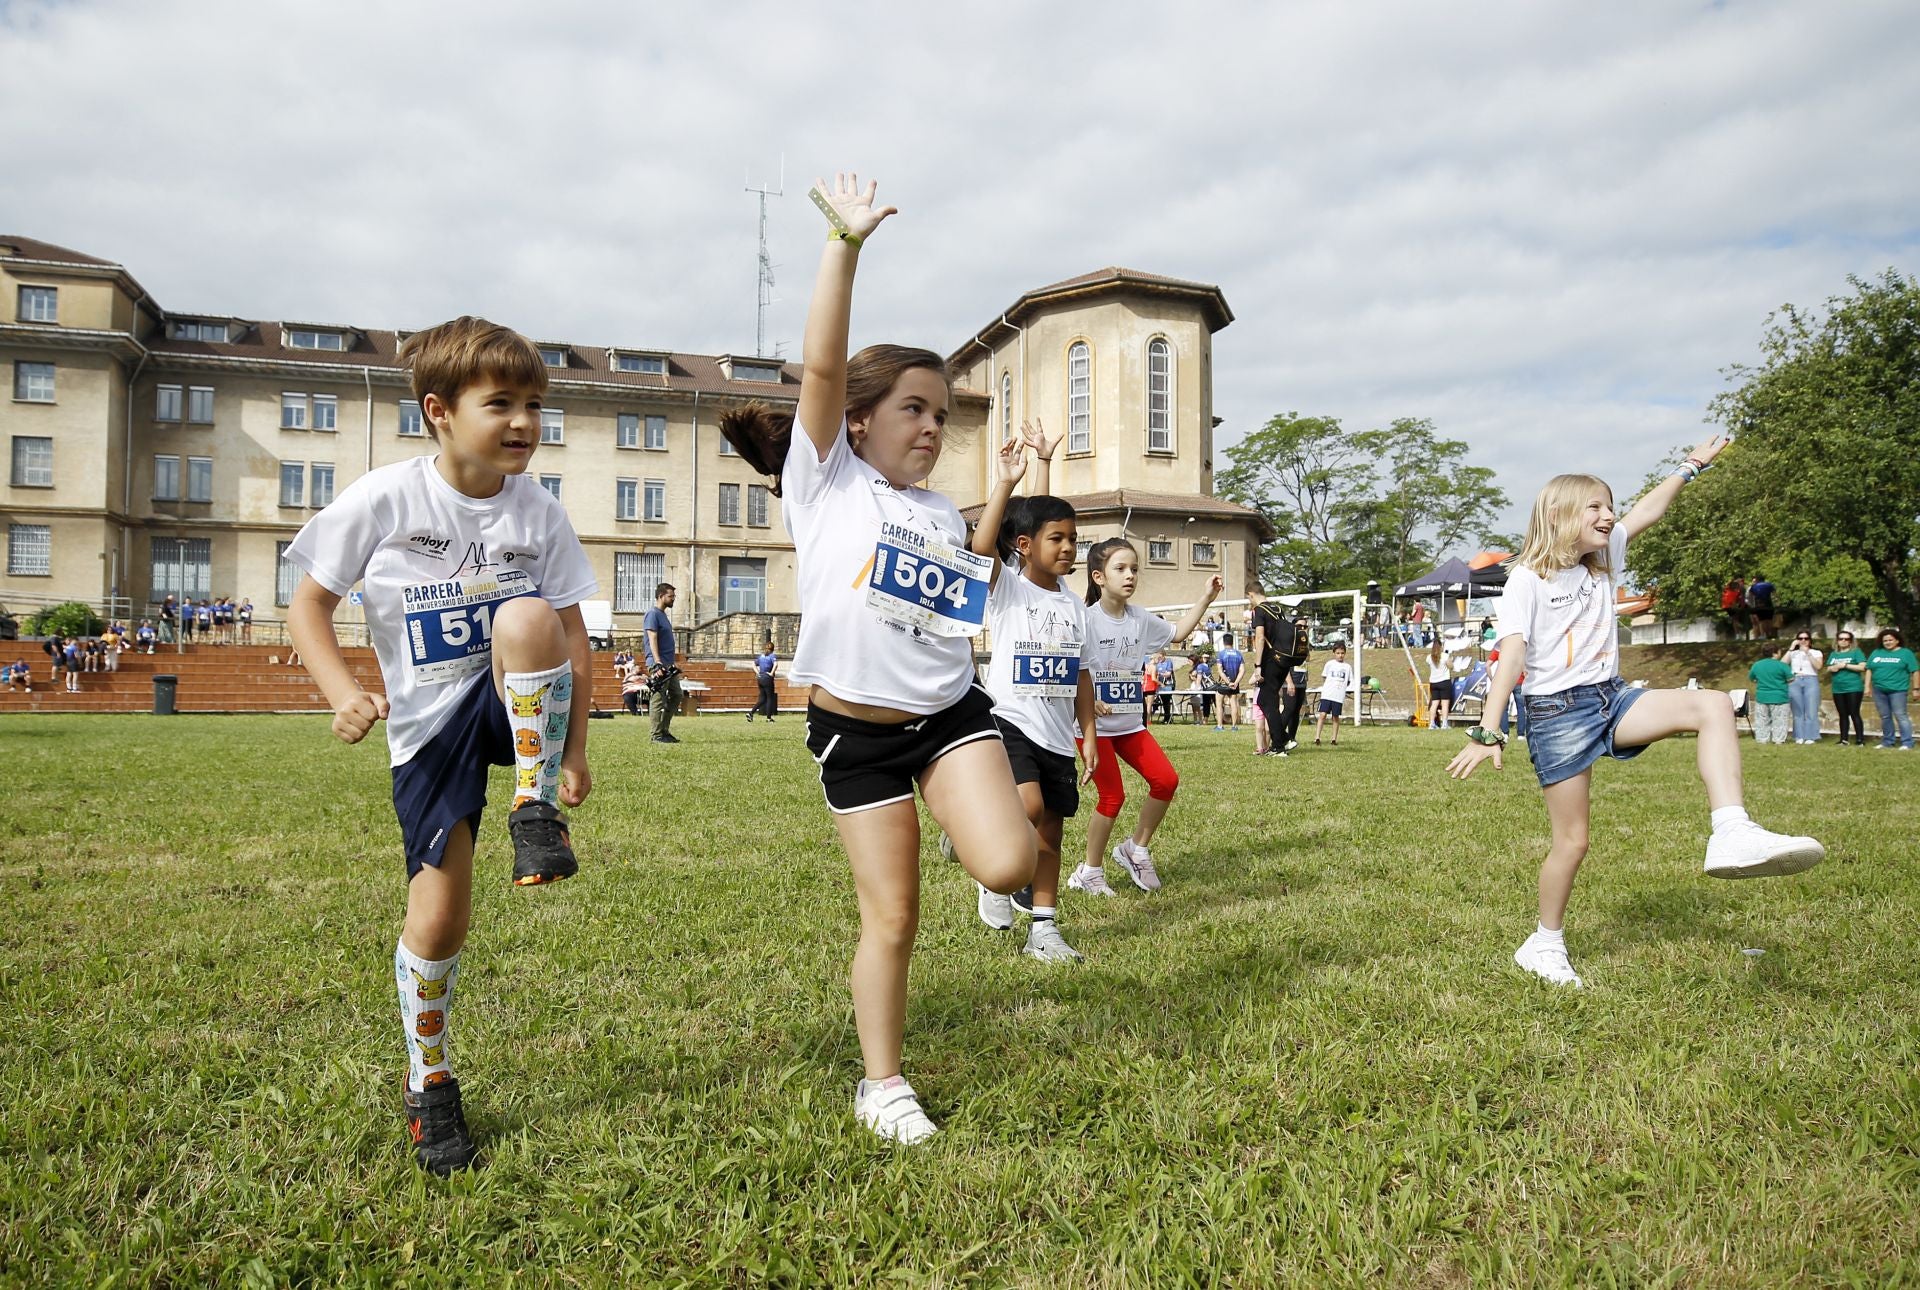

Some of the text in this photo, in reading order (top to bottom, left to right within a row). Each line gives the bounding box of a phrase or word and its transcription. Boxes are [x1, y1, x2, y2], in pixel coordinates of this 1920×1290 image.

[874, 479, 890, 488] enj
[410, 536, 451, 551] enjoy!
[881, 521, 925, 549] CARRERA
[888, 537, 918, 555] ANIVERSARIO
[873, 548, 888, 585] MENORES
[464, 582, 498, 596] SOLIDARIA
[893, 552, 969, 609] 504
[405, 582, 463, 603] CARRERA
[407, 603, 415, 612] 50
[417, 599, 456, 611] ANIVERSARIO
[457, 597, 465, 605] DE
[466, 595, 474, 604] LA
[474, 591, 501, 603] FACULTAD
[501, 587, 515, 597] PADRE
[1551, 593, 1572, 603] enjoy!
[919, 596, 935, 609] IRIA
[440, 605, 492, 646] 51
[410, 619, 428, 660] MENORES
[1014, 641, 1042, 650] CARRERA
[1029, 657, 1068, 678] 514
[1095, 671, 1118, 679] CARRERA
[1110, 683, 1136, 698] 512
